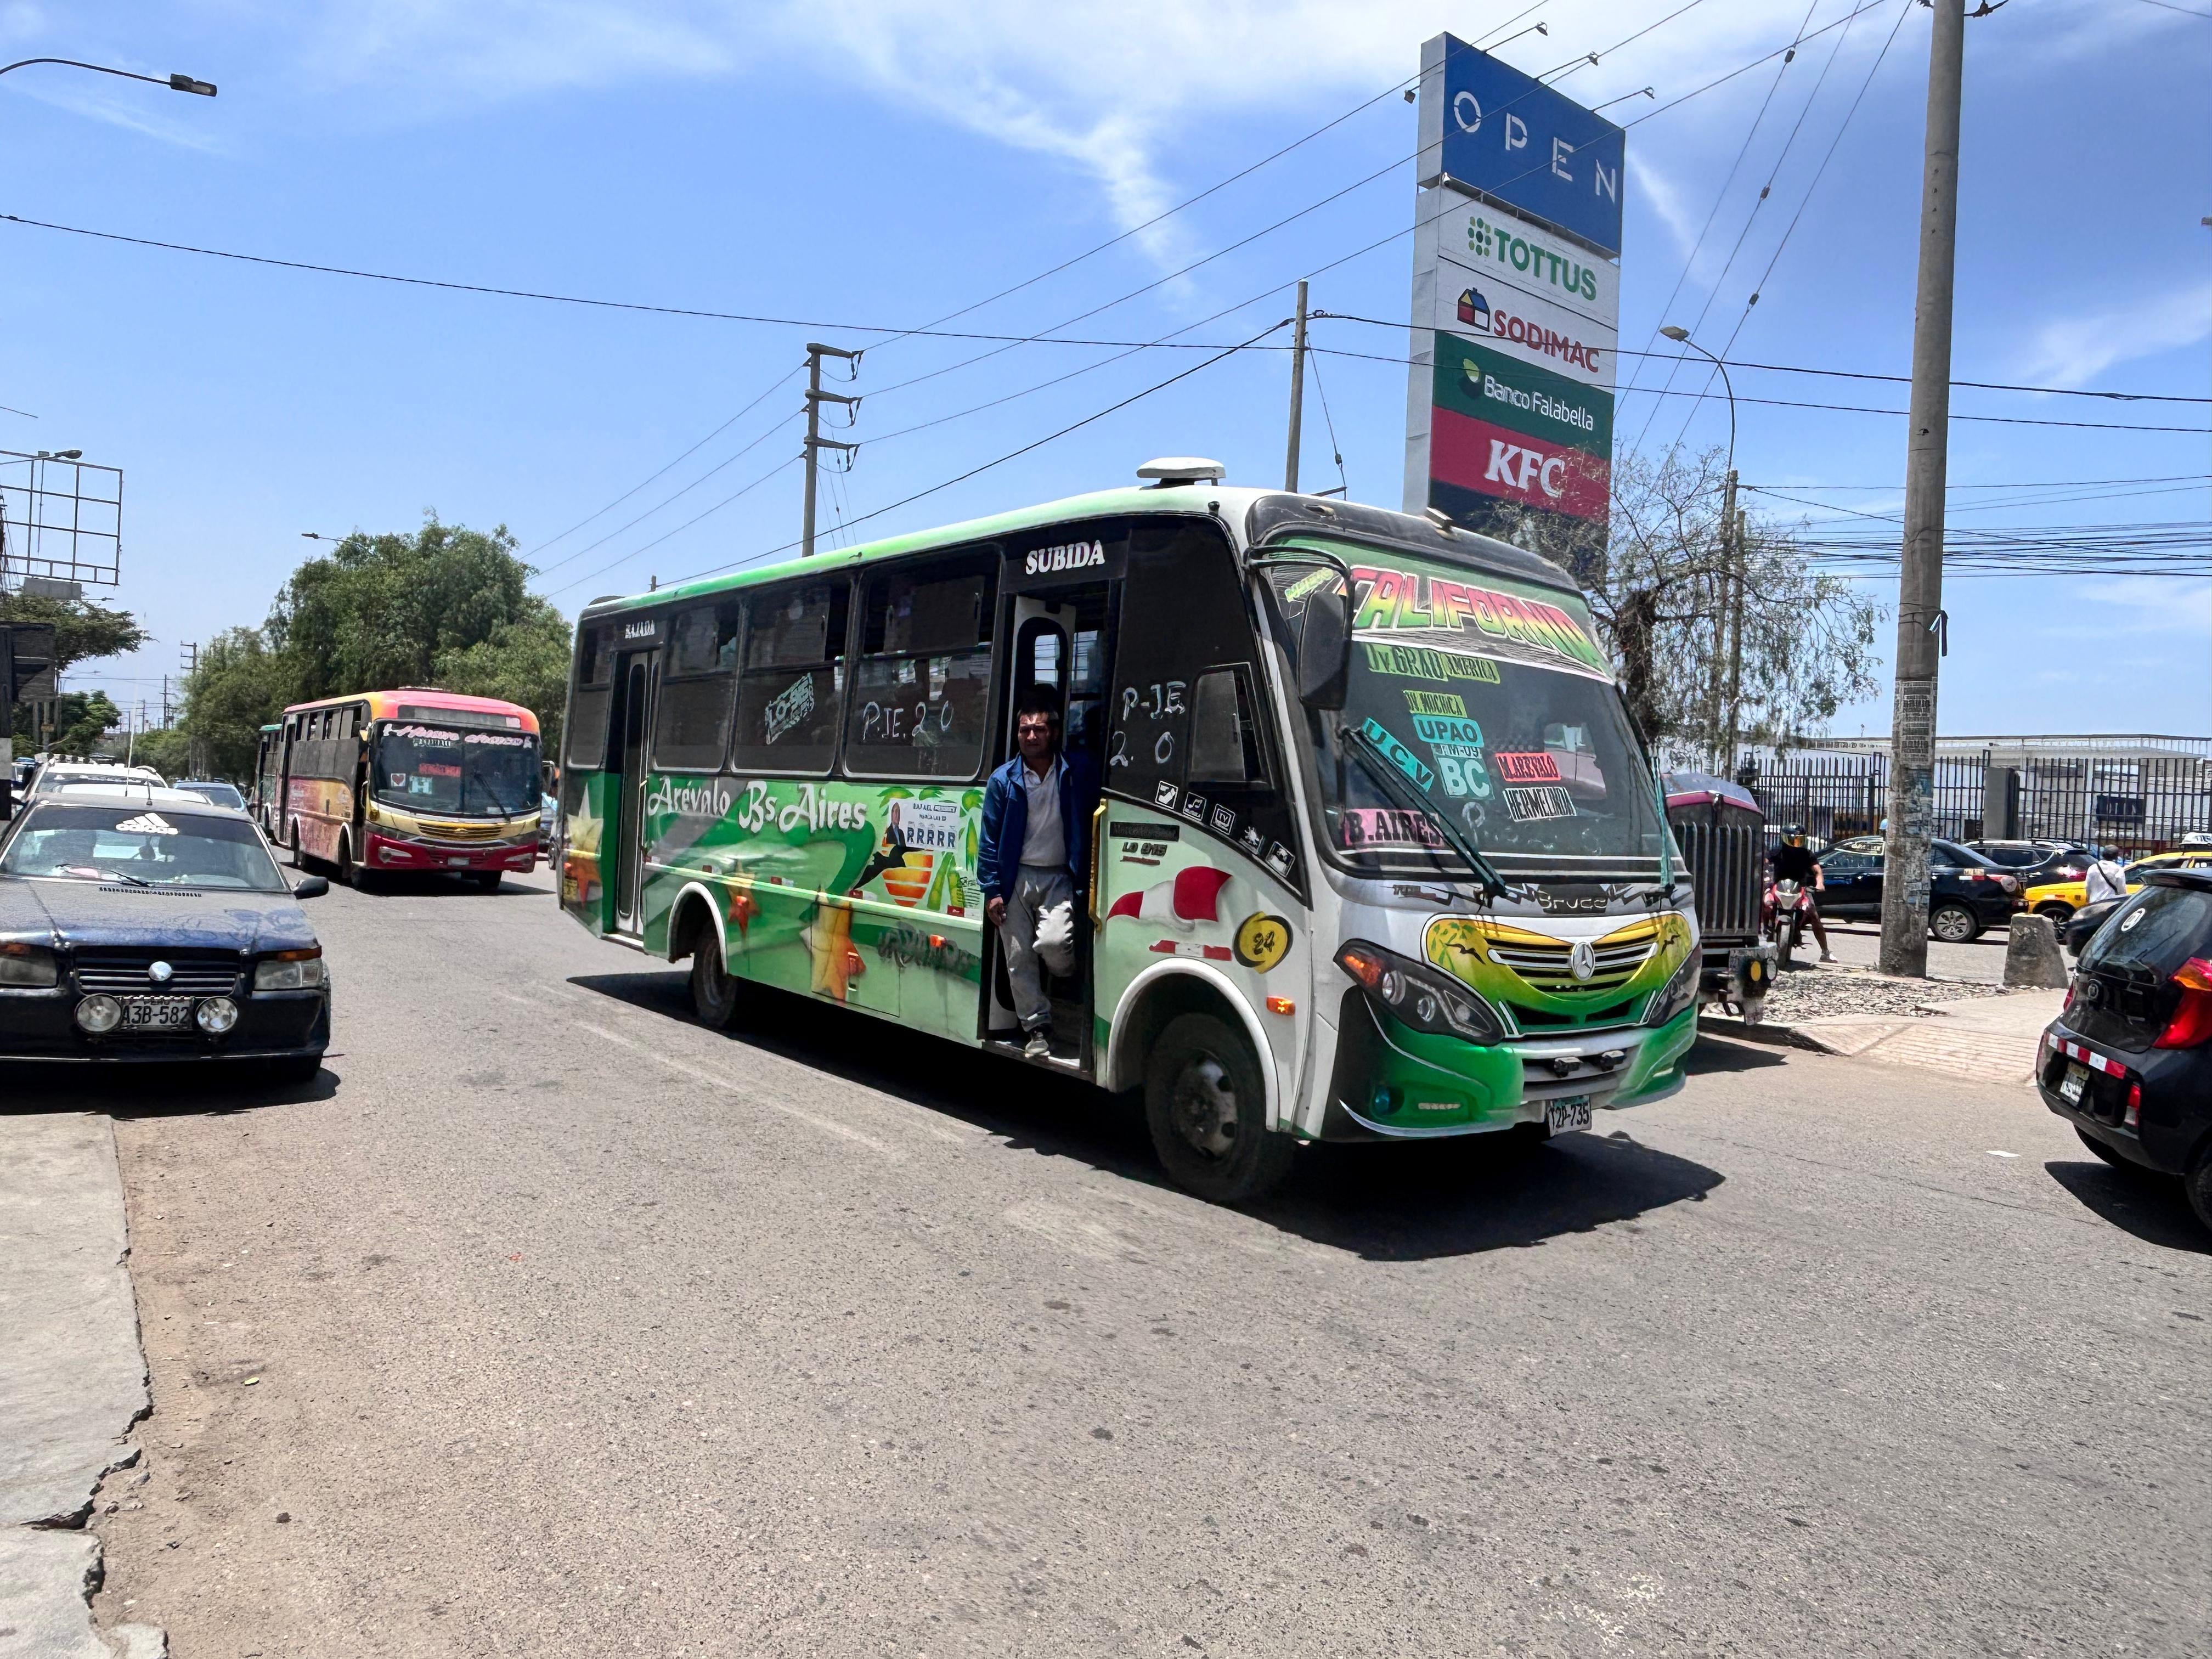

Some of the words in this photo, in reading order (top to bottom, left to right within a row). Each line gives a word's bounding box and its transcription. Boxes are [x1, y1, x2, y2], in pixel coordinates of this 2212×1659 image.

[1454, 91, 1616, 204] OPEN
[1494, 227, 1596, 301] TOTTUS
[1494, 309, 1599, 373] SODIMAC
[1484, 374, 1530, 410] Banco
[1532, 391, 1594, 431] Falabella
[1483, 439, 1565, 499] KFC
[1025, 539, 1105, 575] SUBIDA
[1365, 722, 1431, 785] UCV
[1418, 718, 1478, 743] UPAO
[648, 775, 731, 816] Arévalo
[1438, 758, 1490, 798] BC
[1252, 930, 1275, 955] 24
[122, 1005, 190, 1024] A3B-582
